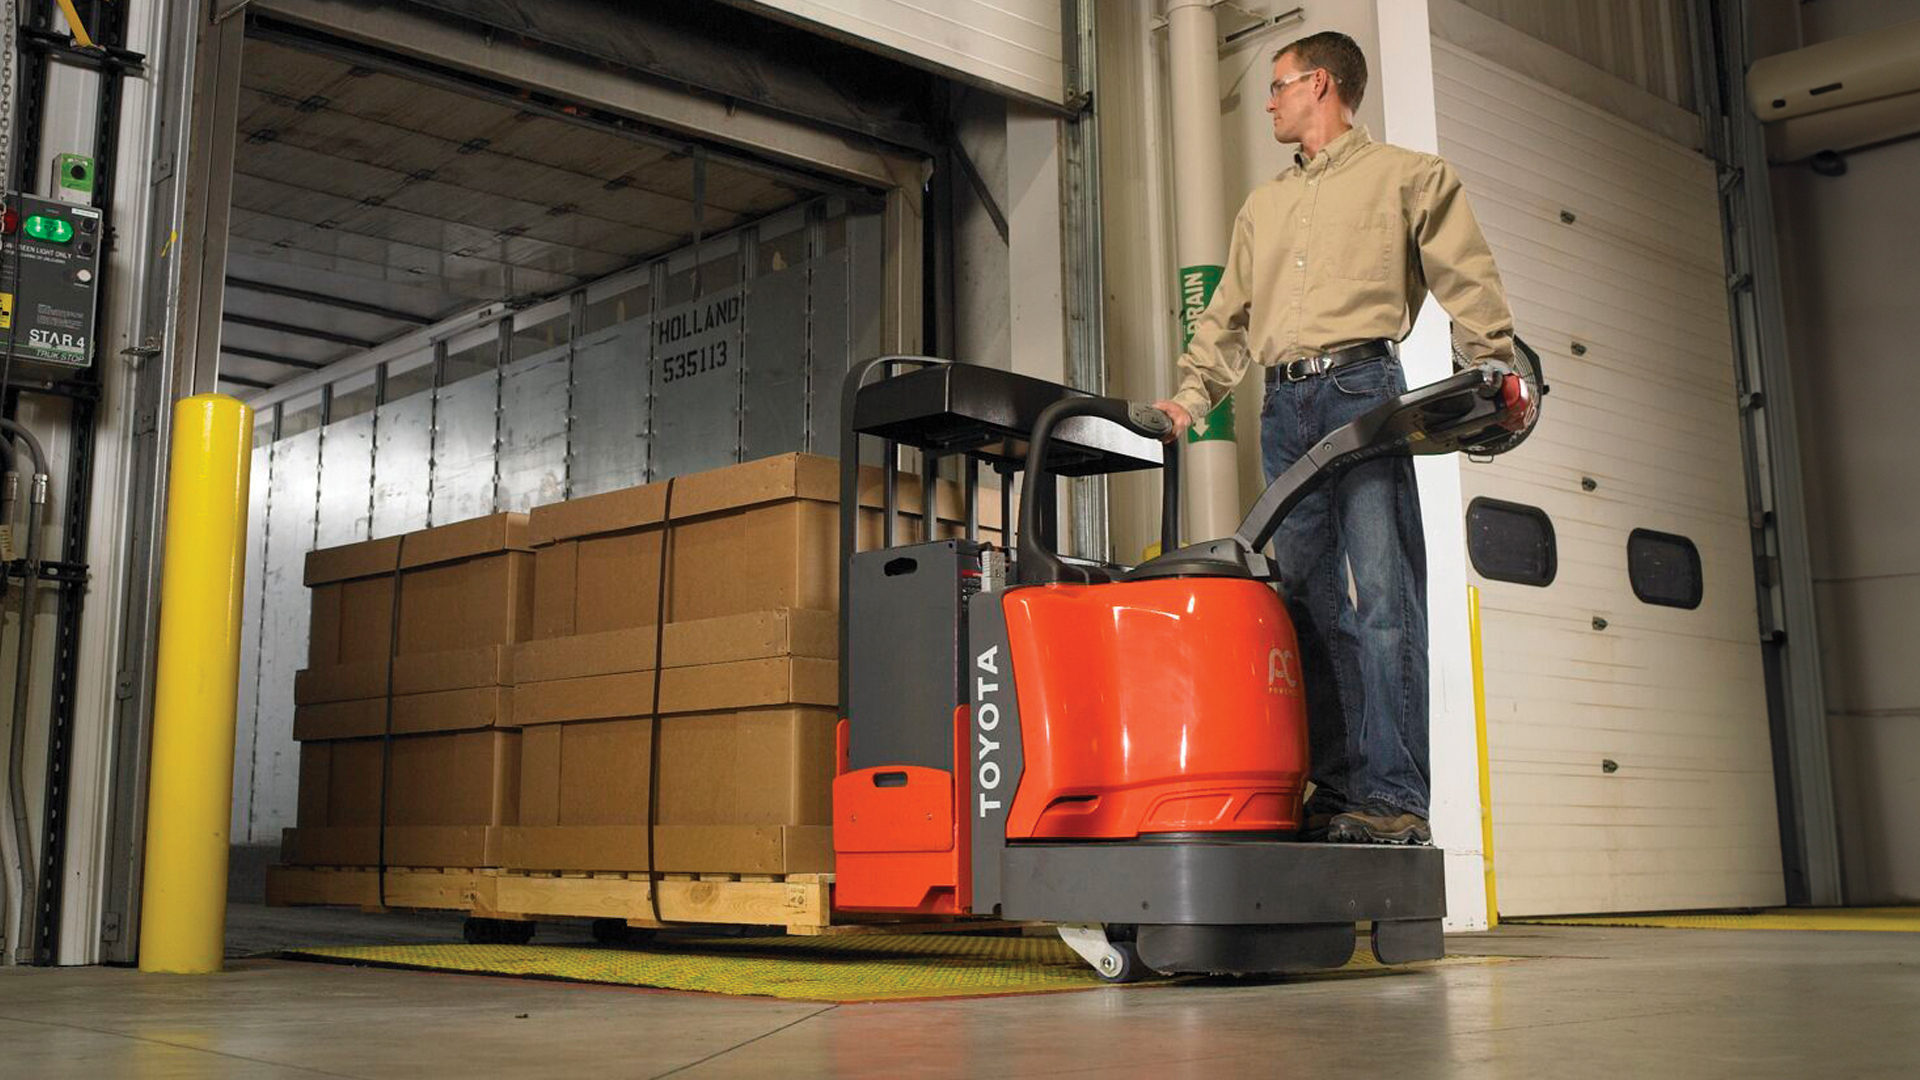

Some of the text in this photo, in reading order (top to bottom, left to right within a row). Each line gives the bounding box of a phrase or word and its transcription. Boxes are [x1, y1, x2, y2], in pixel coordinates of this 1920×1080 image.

[29, 328, 86, 348] STAR 4
[658, 297, 740, 345] HOLLAND
[60, 353, 85, 363] STOP
[663, 340, 728, 383] 535113
[977, 644, 1001, 818] TOYOTA
